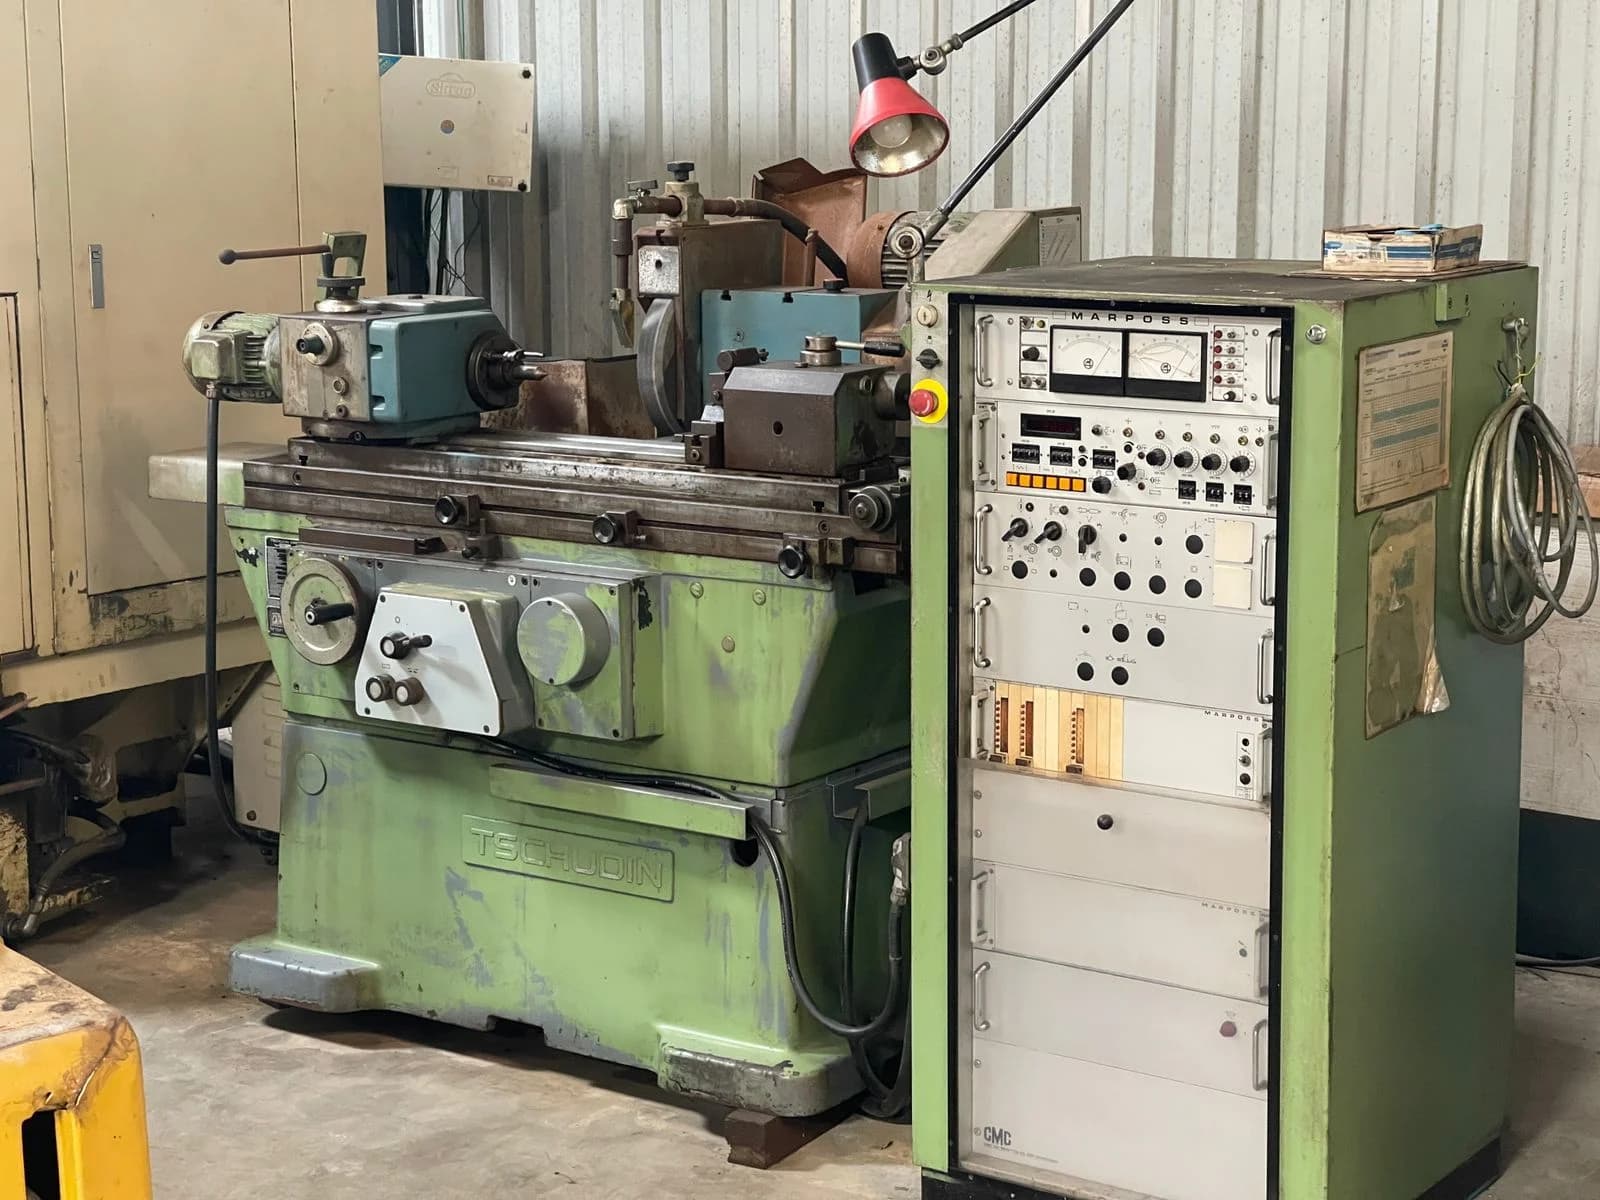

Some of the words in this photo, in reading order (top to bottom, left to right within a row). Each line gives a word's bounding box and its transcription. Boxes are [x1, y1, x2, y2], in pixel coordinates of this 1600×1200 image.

[1071, 311, 1189, 326] MARPOSS
[1204, 710, 1260, 722] MARPOSS
[470, 827, 664, 890] TSCHUDIN
[1201, 901, 1257, 917] MARPOSS
[984, 1126, 1012, 1146] CMC
